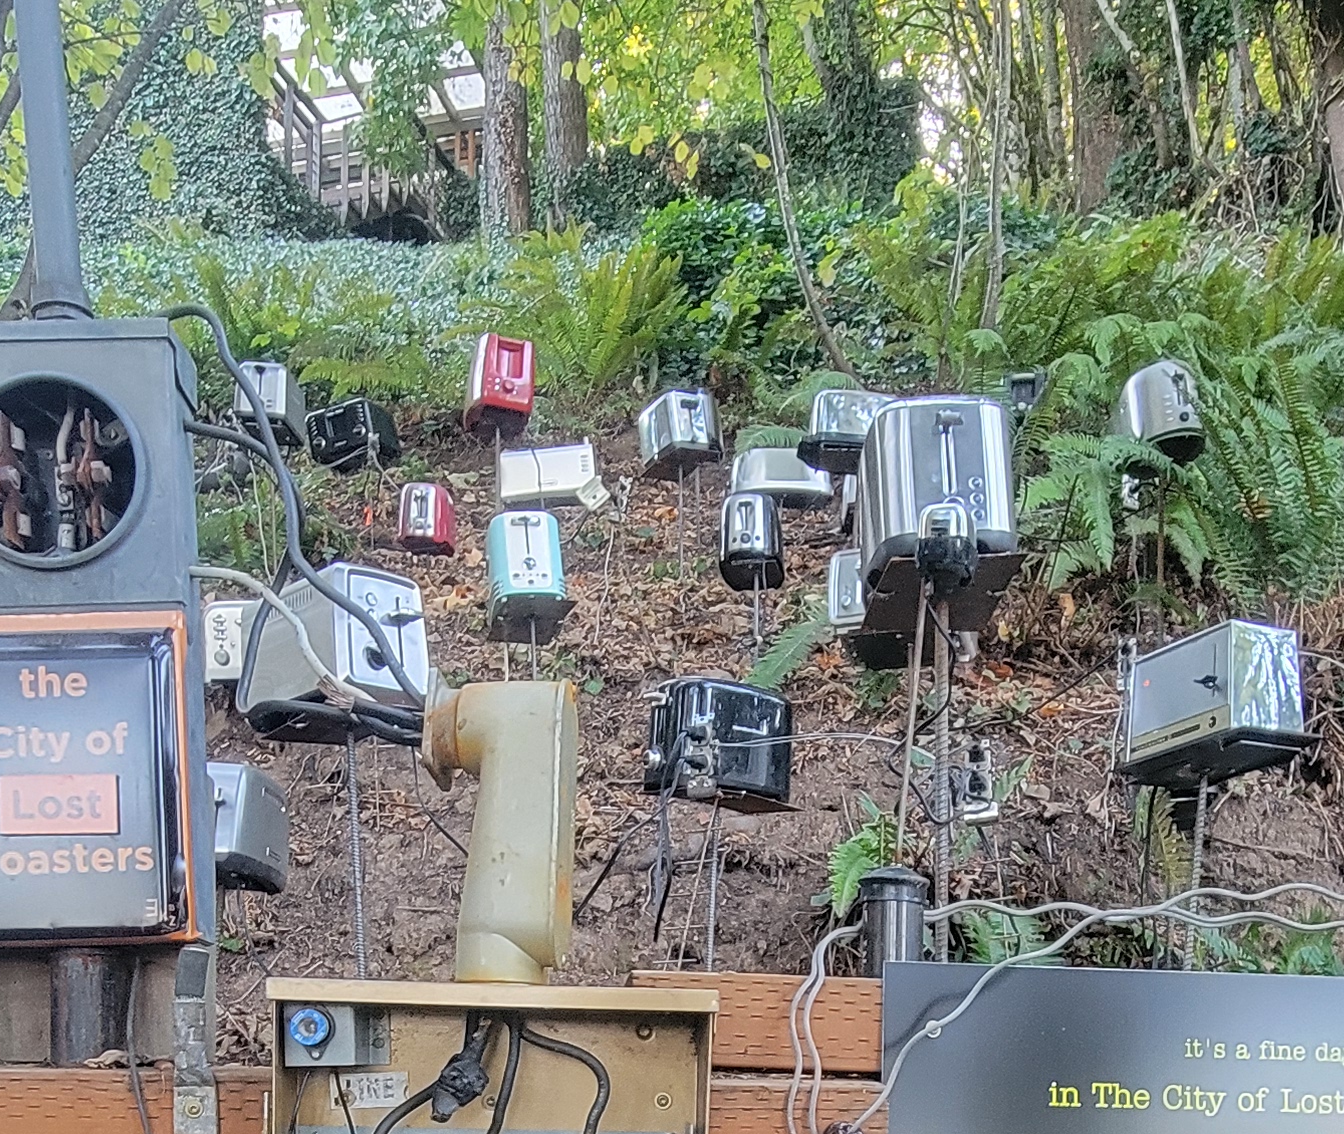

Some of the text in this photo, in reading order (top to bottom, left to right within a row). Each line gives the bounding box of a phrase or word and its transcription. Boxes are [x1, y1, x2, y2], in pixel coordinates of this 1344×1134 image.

[19, 666, 88, 698] the
[86, 721, 129, 755] of
[12, 789, 103, 821] Lost
[1184, 1038, 1226, 1059] it's
[1235, 1043, 1251, 1060] a
[1258, 1040, 1306, 1061] fine
[1048, 1081, 1082, 1108] in
[1091, 1082, 1151, 1110] The
[1162, 1084, 1227, 1117] City
[1237, 1087, 1270, 1112] of
